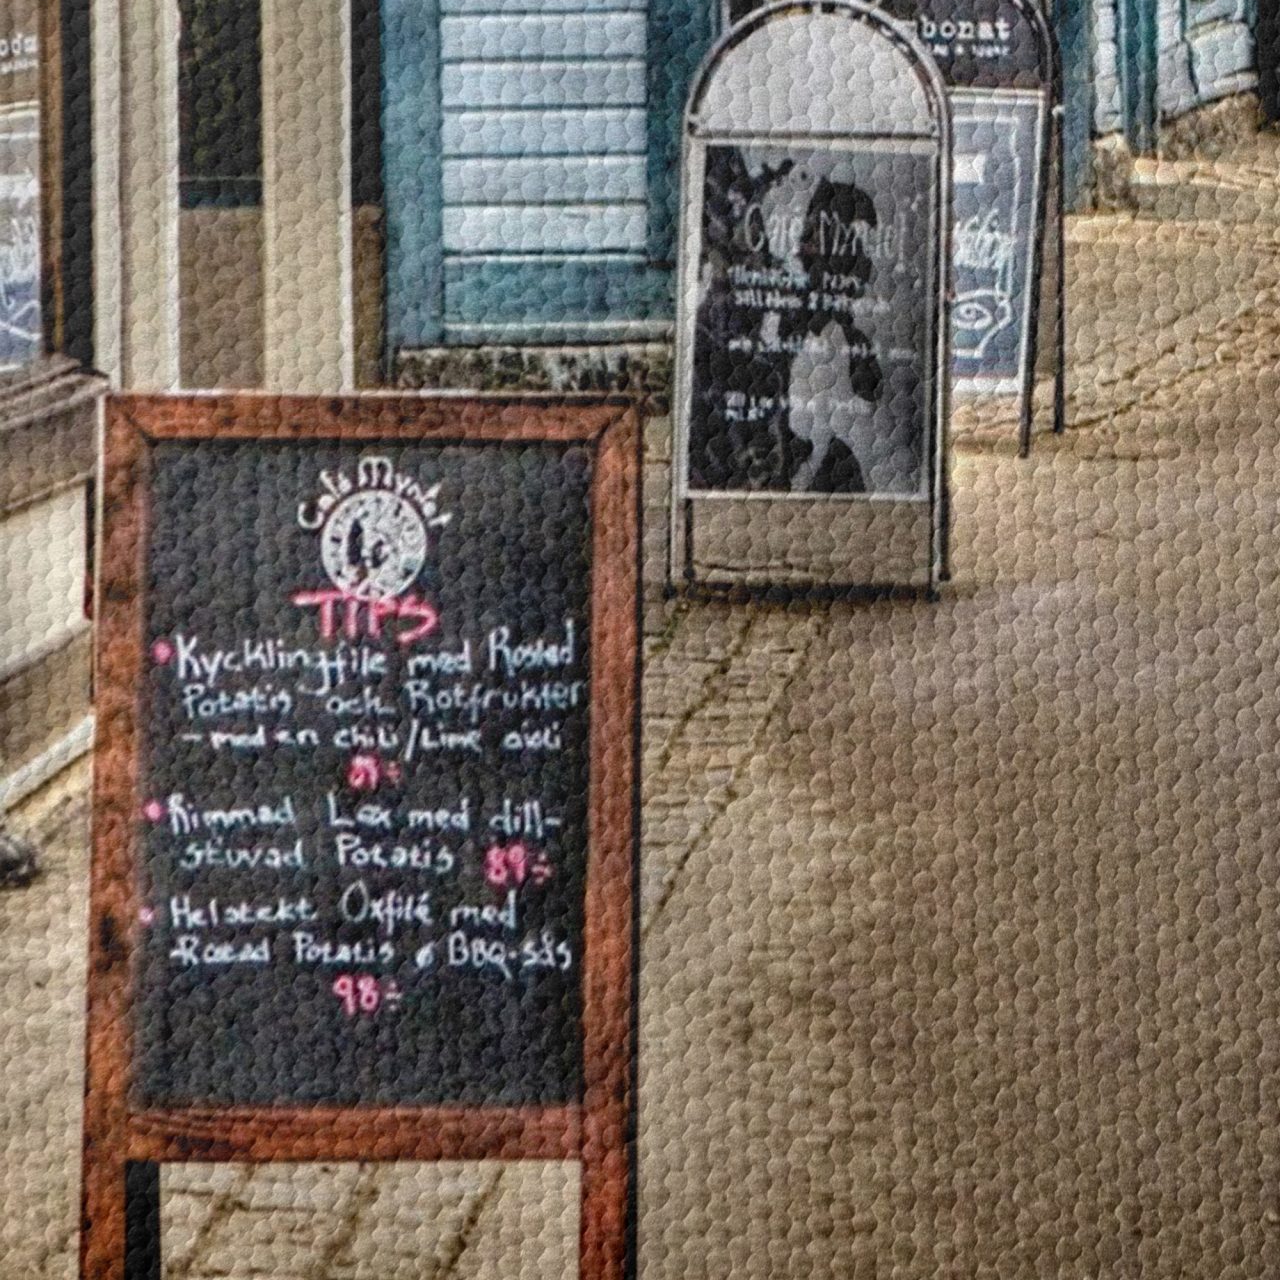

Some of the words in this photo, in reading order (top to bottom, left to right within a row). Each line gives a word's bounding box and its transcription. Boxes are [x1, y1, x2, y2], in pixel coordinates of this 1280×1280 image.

[289, 588, 437, 644] TIPS
[408, 638, 471, 676] med
[407, 798, 469, 831] med
[450, 888, 516, 929] med
